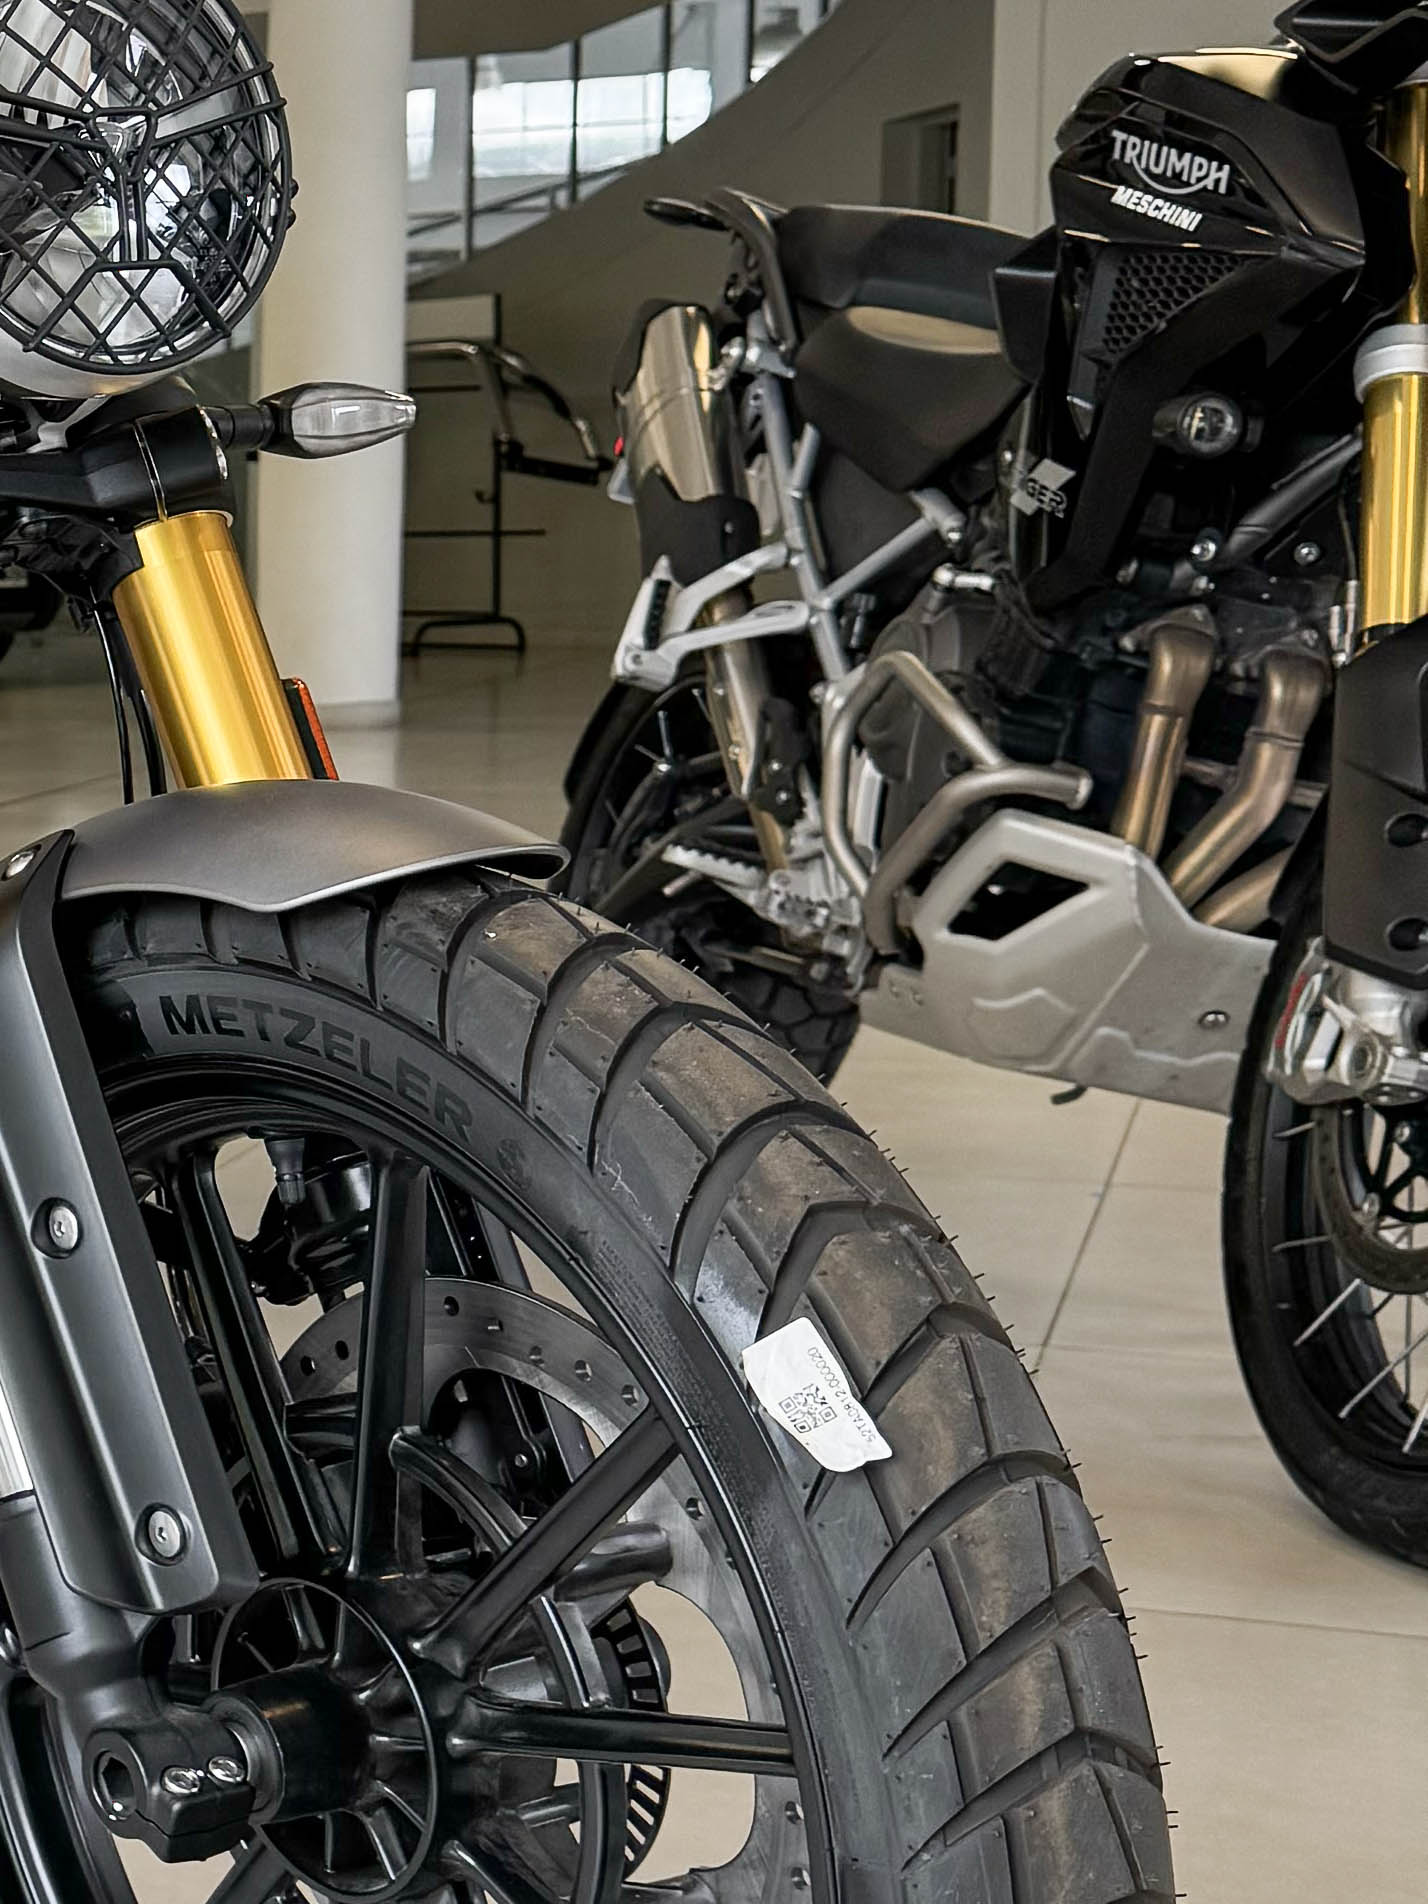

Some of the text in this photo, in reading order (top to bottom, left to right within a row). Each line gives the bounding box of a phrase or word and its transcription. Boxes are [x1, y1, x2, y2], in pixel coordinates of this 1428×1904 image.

[1111, 129, 1231, 195] TRIUMPH
[1110, 185, 1203, 232] MESCHINI
[158, 994, 474, 1147] METZELER
